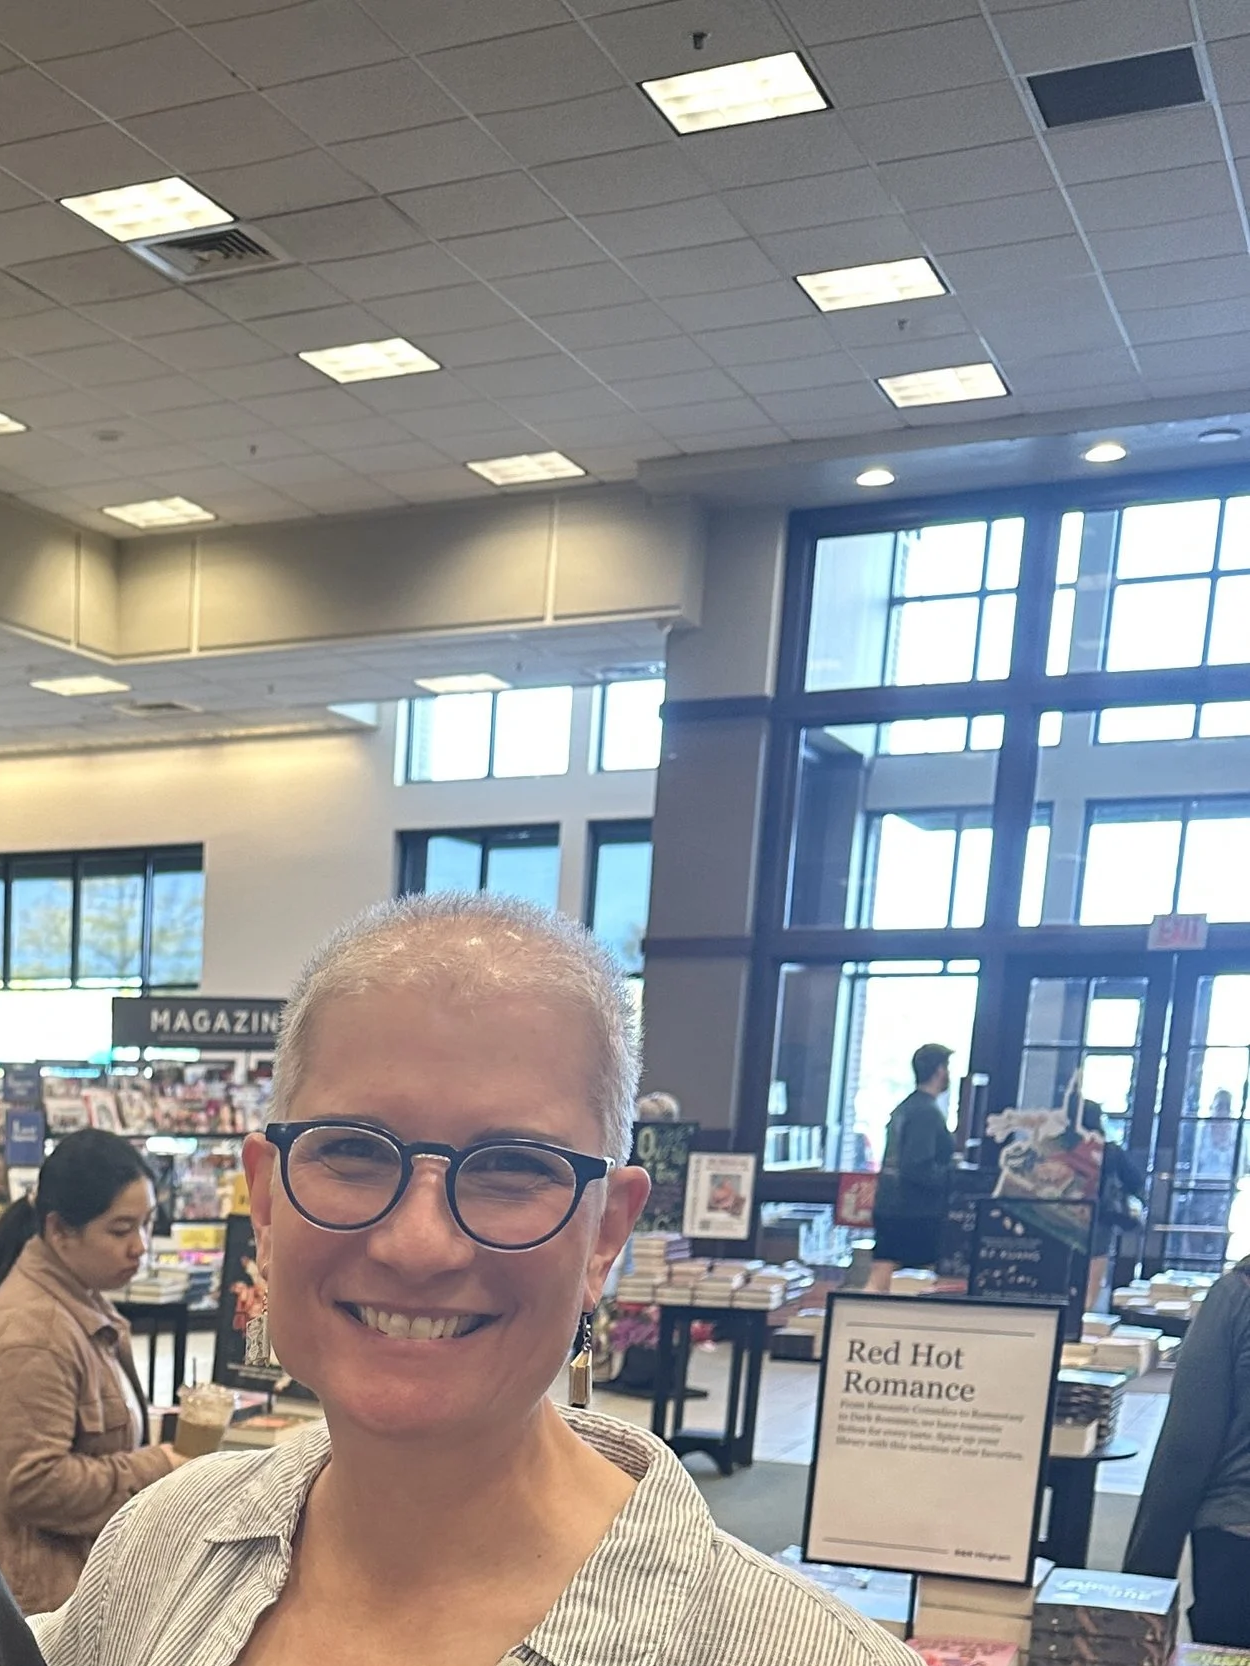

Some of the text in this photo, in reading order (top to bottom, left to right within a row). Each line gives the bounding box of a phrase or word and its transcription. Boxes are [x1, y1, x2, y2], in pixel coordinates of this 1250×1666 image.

[846, 1338, 965, 1370] Red Hot
[843, 1370, 975, 1402] Romance
